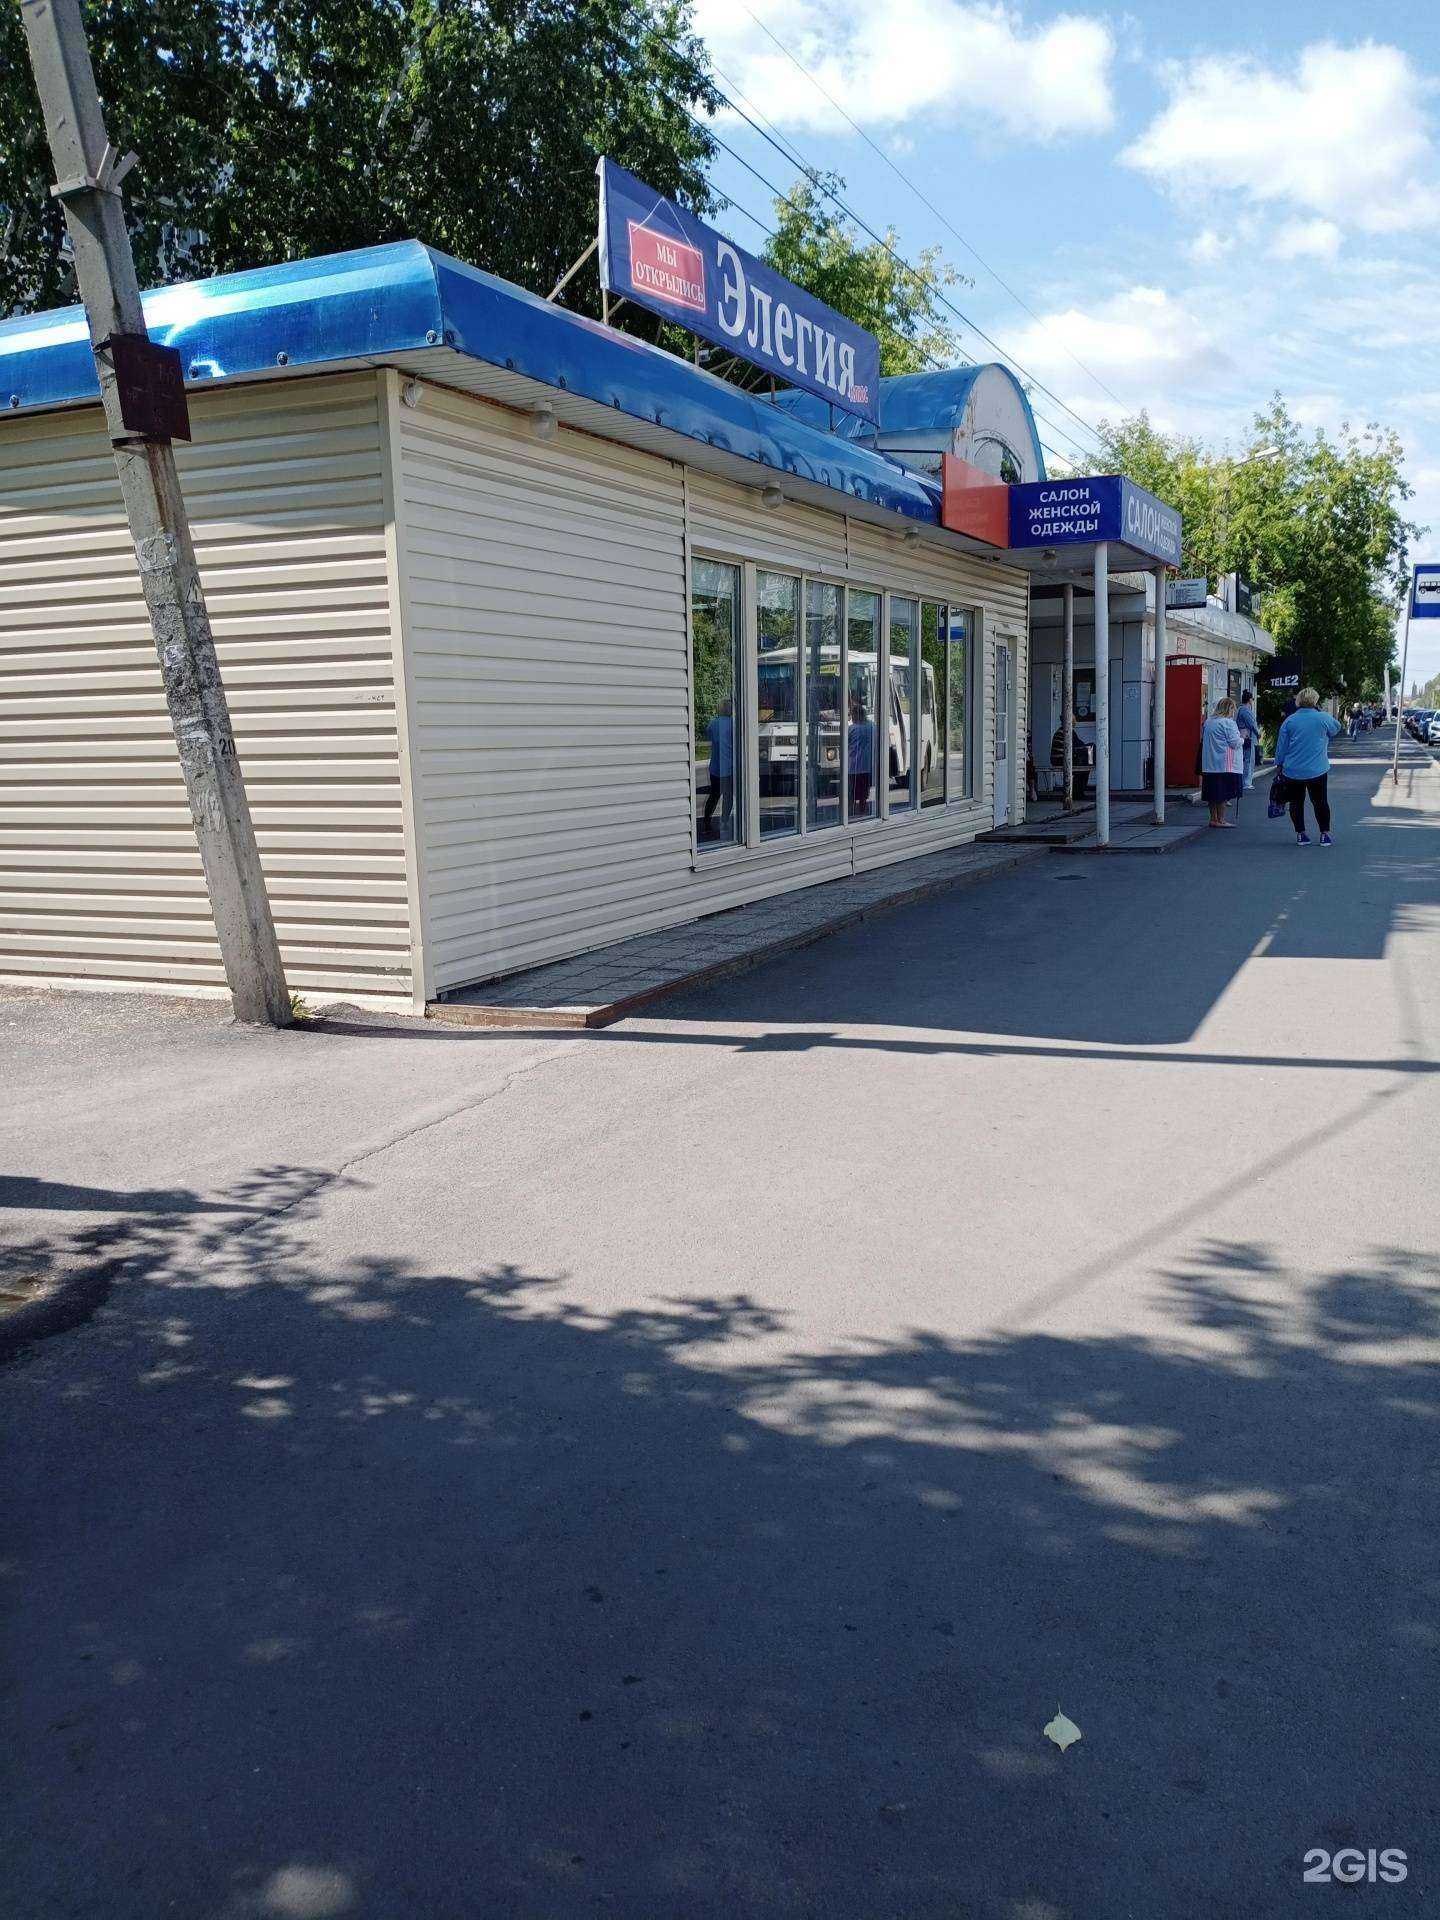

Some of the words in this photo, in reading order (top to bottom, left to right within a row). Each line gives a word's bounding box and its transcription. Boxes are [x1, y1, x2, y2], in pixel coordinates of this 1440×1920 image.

[656, 243, 677, 267] МЫ
[635, 260, 704, 302] ОТКРЫЛИСЬ
[717, 240, 856, 398] Элегия
[1039, 487, 1090, 503] САЛОН
[1028, 500, 1101, 520] ЖЕНСКОЙ
[1128, 495, 1161, 546] САЛОН
[1031, 519, 1098, 536] ОДЕЖДЫ
[1270, 674, 1299, 687] TELE2
